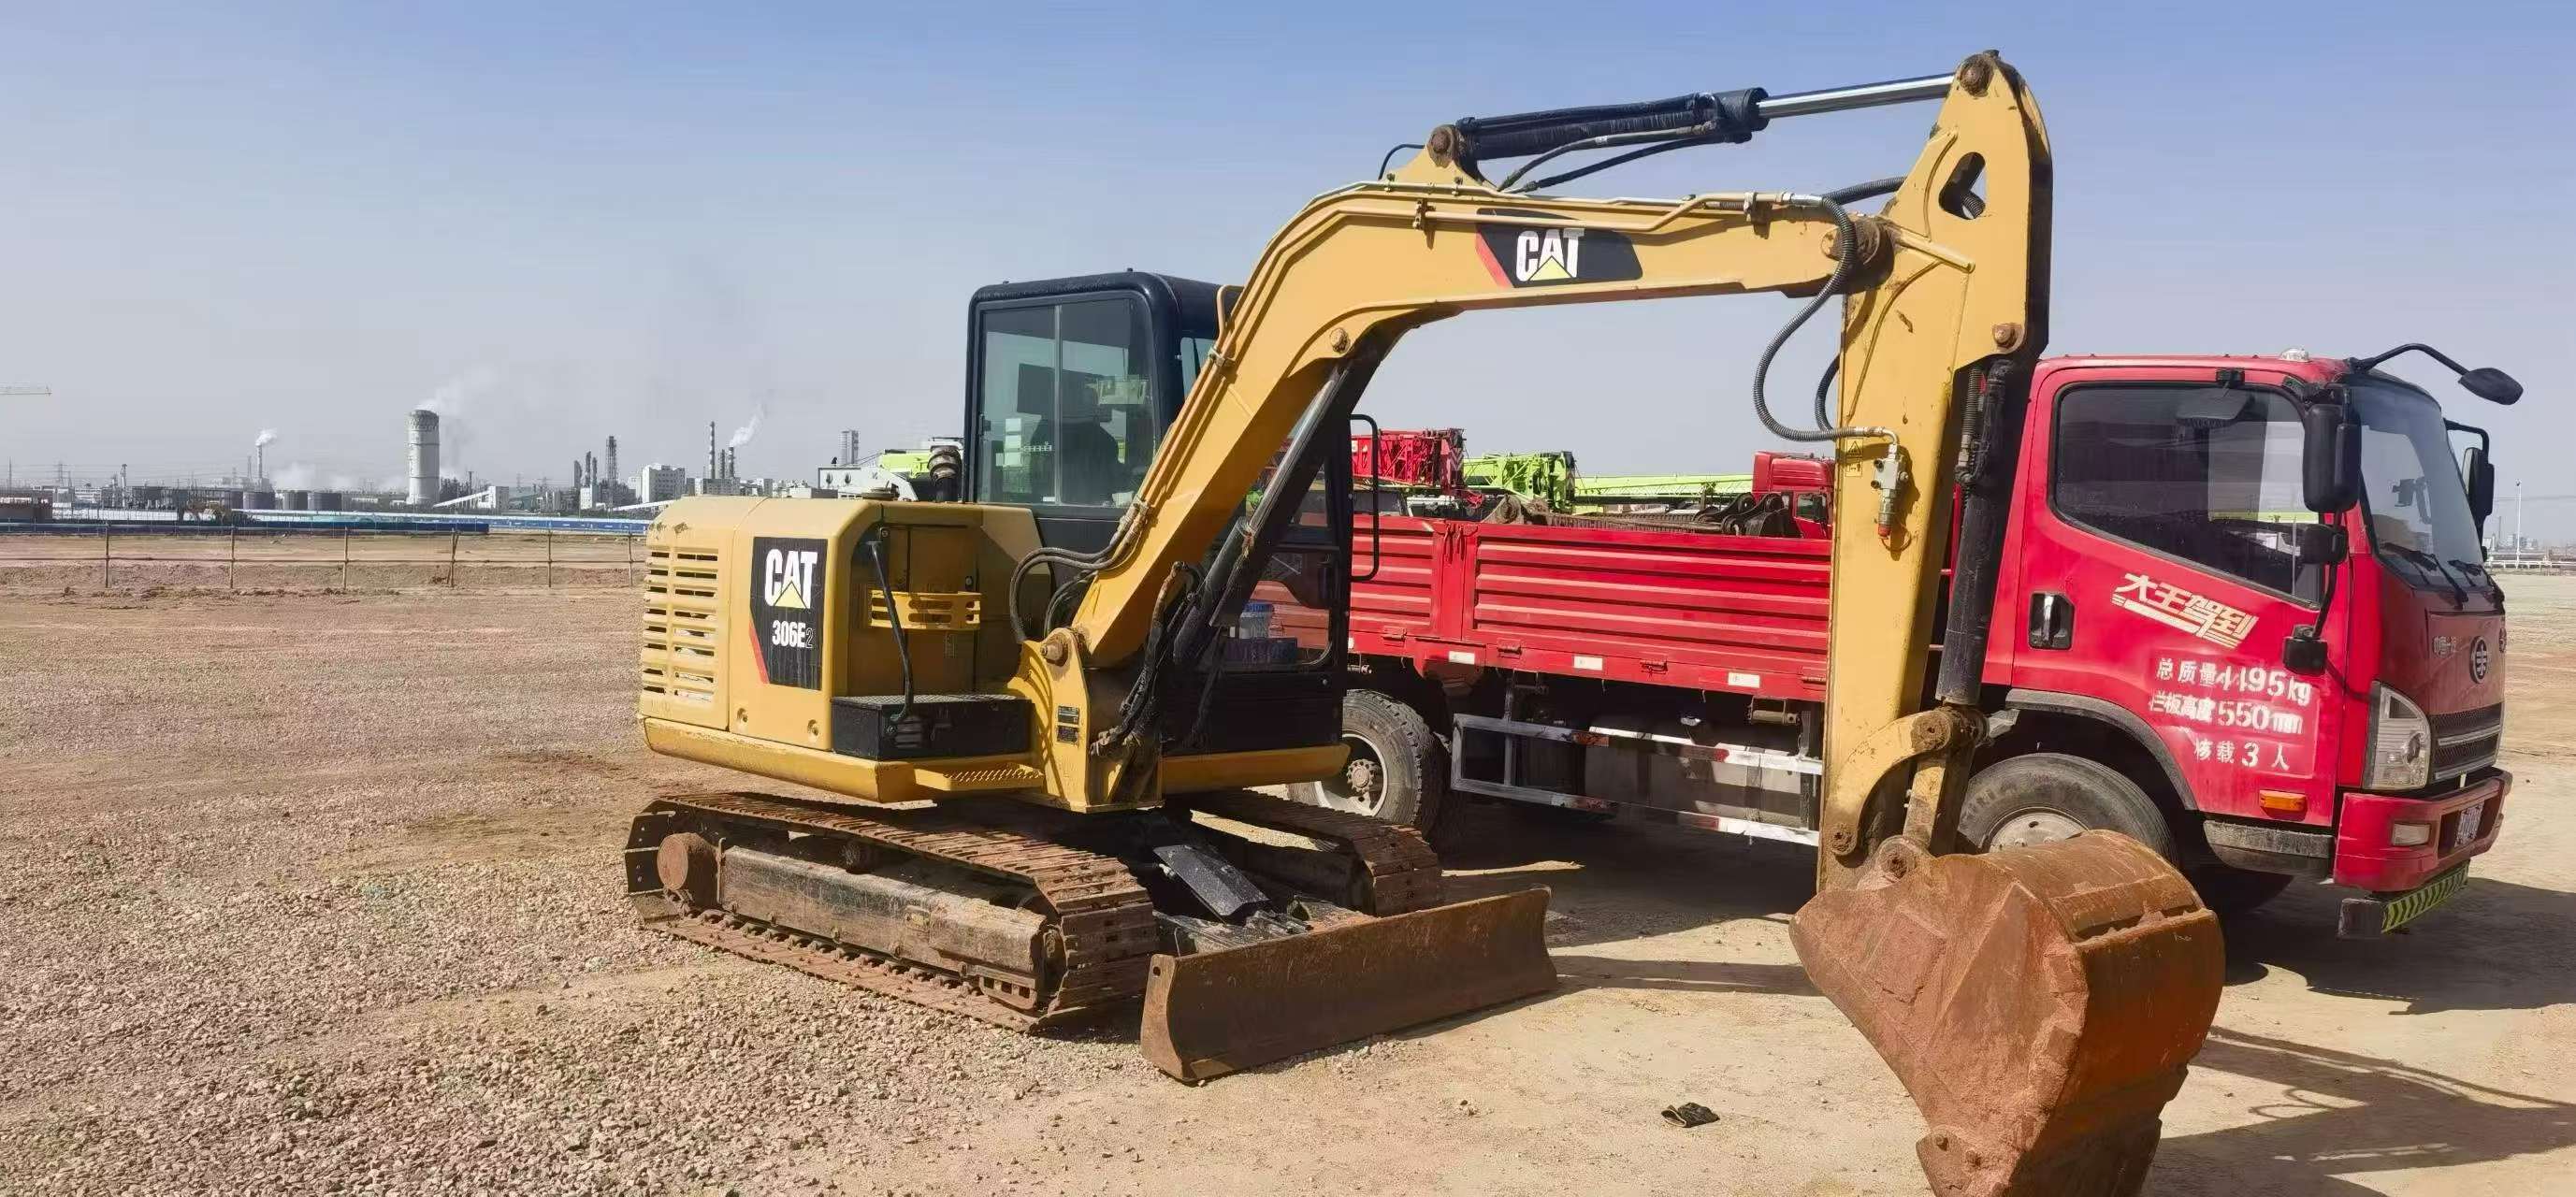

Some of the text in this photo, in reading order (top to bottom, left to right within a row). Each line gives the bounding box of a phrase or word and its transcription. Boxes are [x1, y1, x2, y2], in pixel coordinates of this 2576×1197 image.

[1516, 228, 1585, 281] CAT
[764, 548, 818, 609] CAT
[772, 619, 814, 648] 306E2
[2113, 572, 2260, 645] 大王驾到
